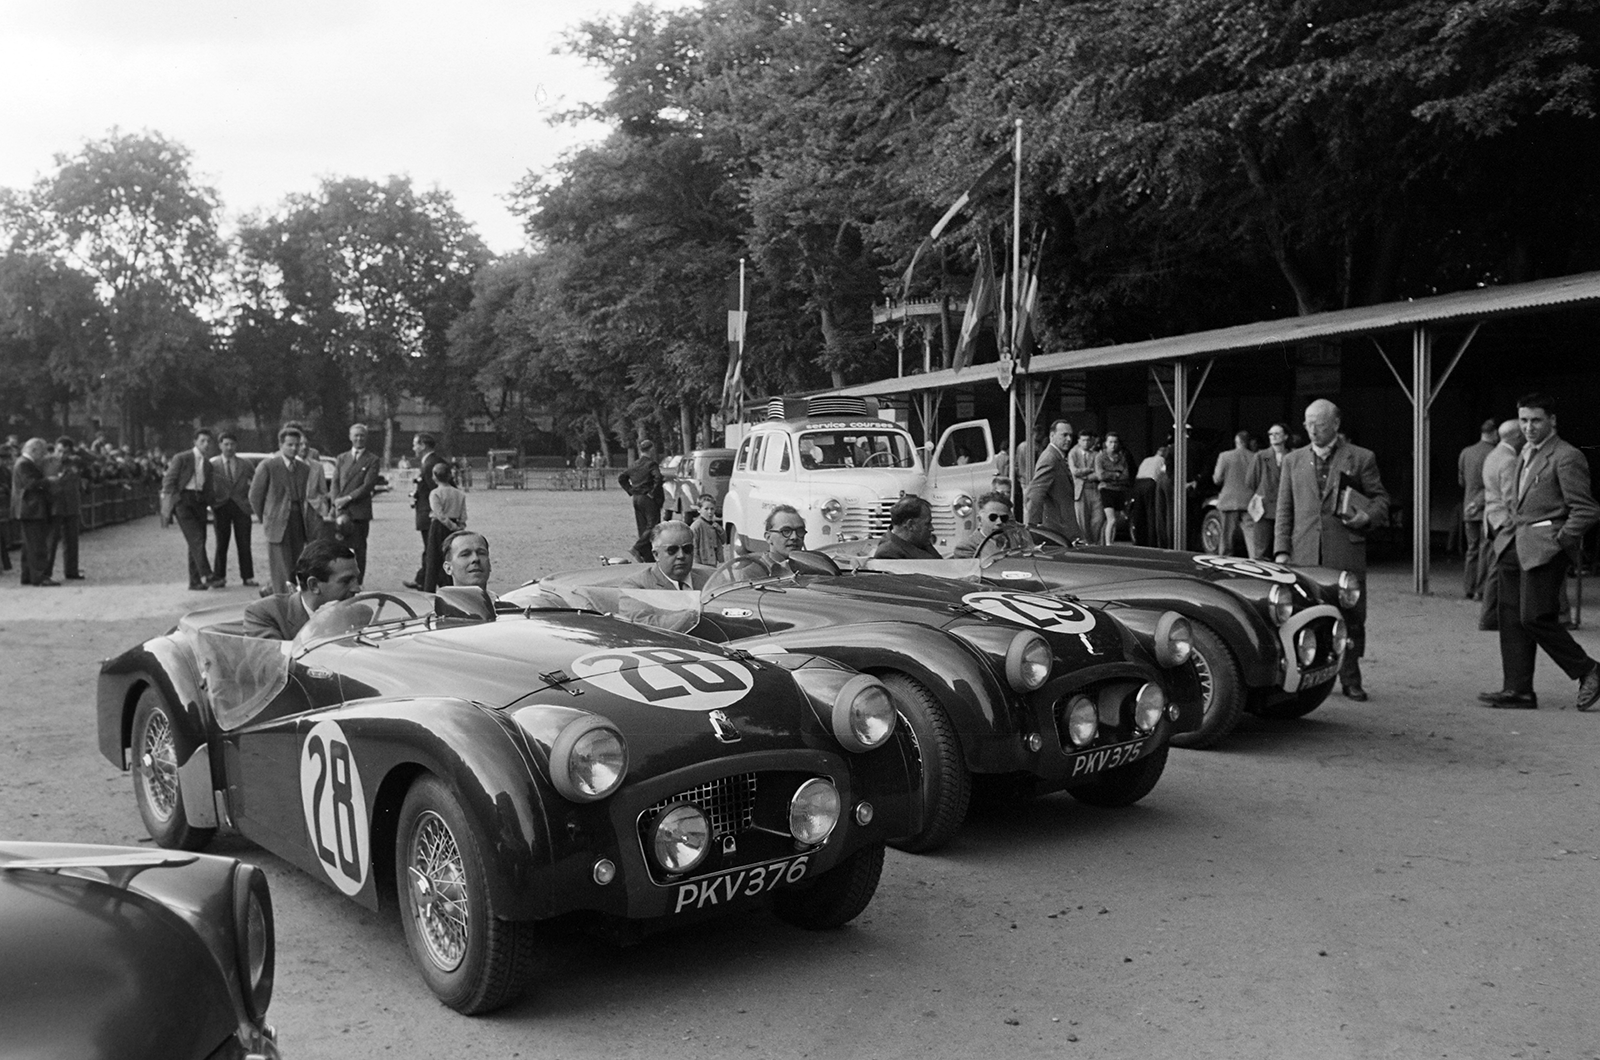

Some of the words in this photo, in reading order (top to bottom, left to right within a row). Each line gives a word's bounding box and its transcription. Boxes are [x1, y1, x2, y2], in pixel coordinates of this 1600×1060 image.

[806, 422, 846, 430] service
[968, 593, 1086, 629] 29
[579, 649, 748, 703] 28
[1072, 741, 1143, 777] PKV375
[307, 734, 362, 884] 28
[675, 856, 809, 914] PKV376
